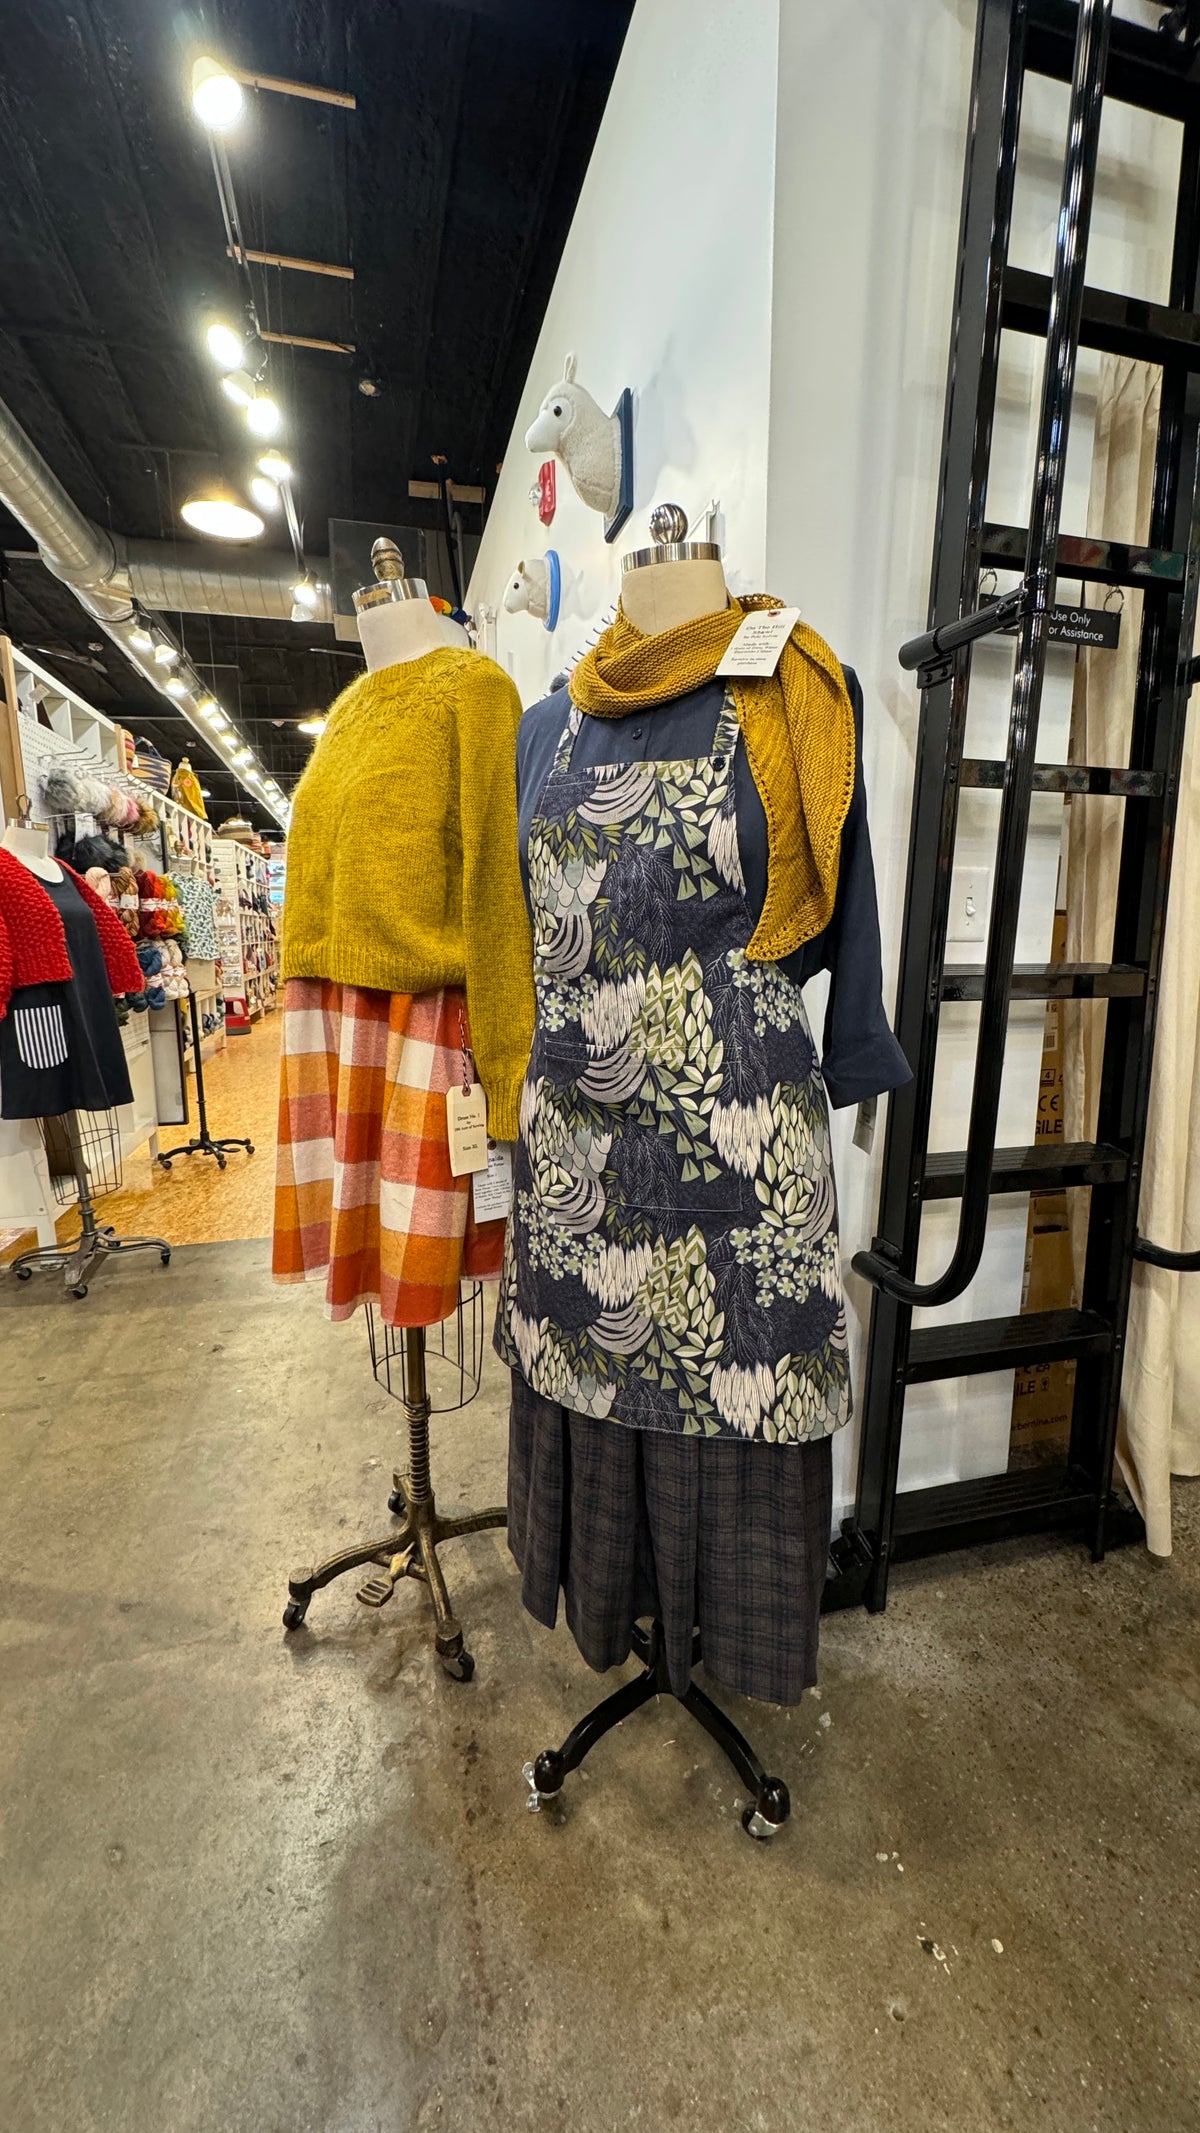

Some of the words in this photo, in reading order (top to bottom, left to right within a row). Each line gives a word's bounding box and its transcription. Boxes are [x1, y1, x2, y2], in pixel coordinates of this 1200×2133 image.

[1070, 612, 1092, 627] Only
[1048, 625, 1058, 635] or
[1060, 625, 1104, 641] Assistance
